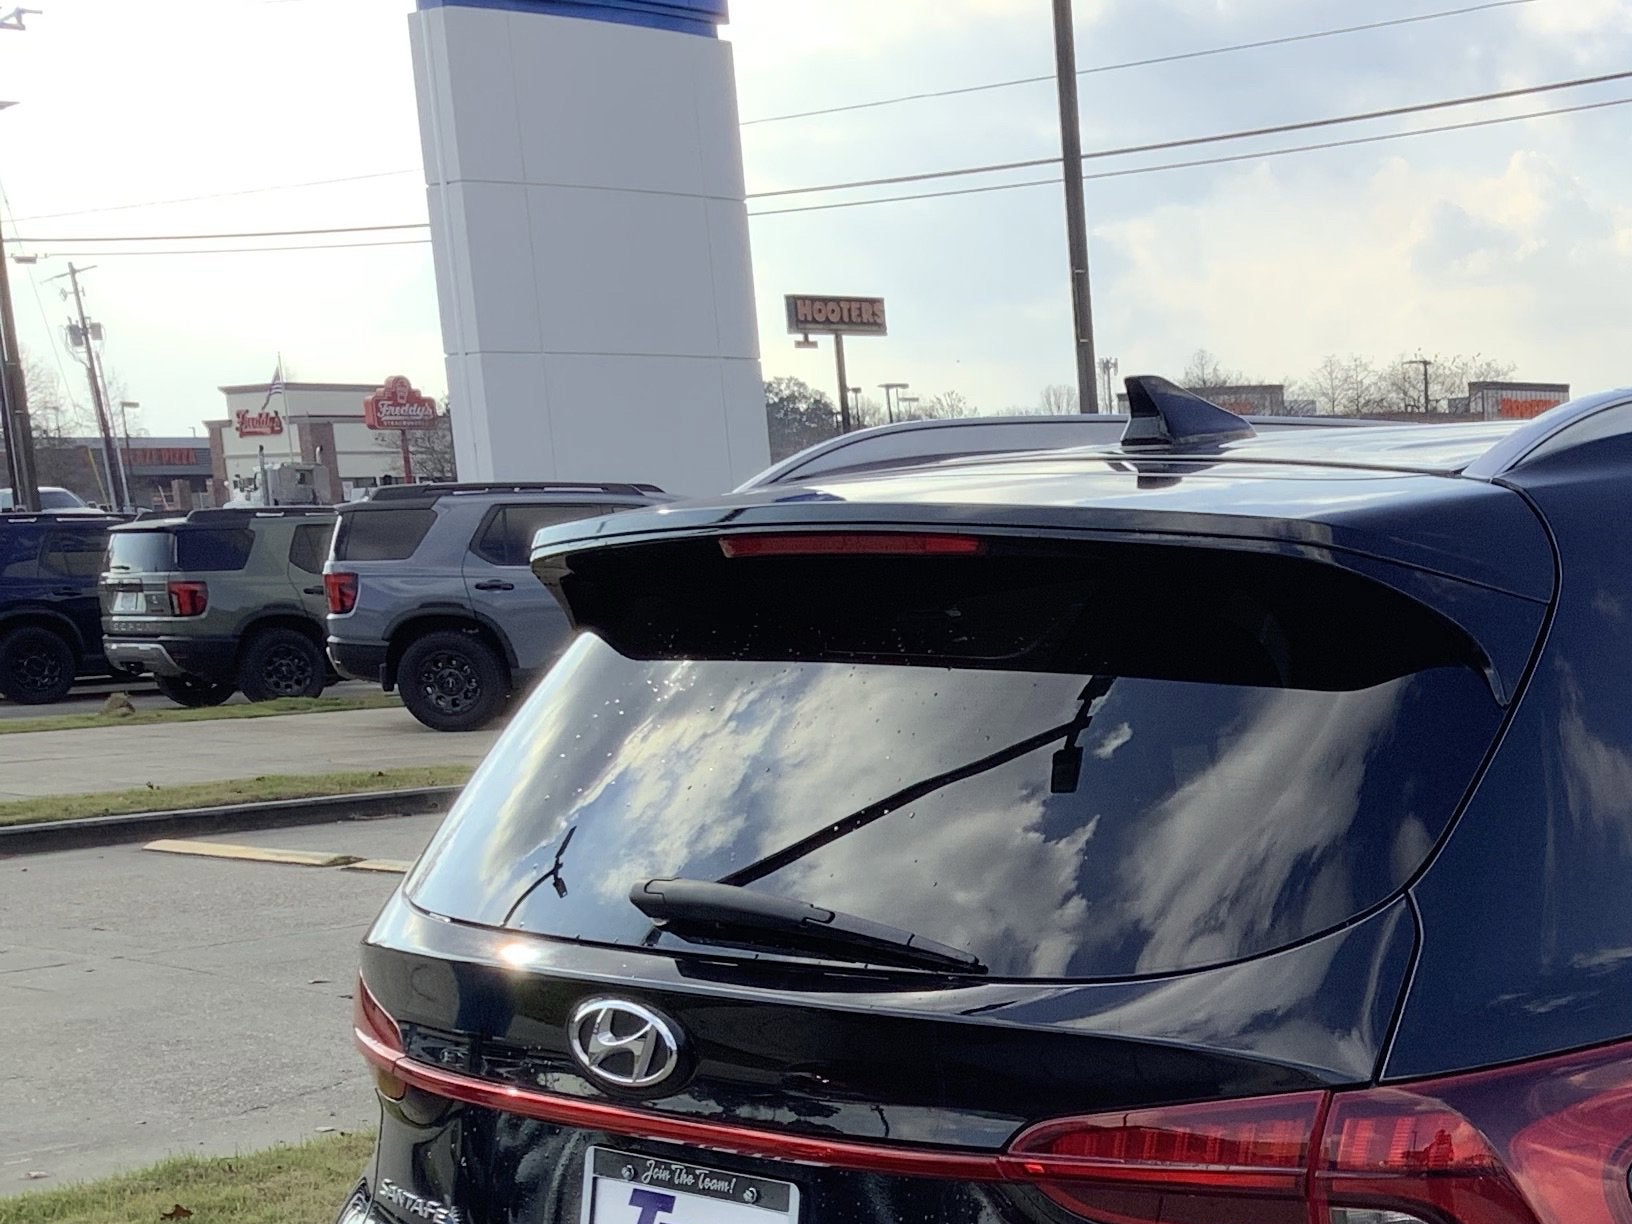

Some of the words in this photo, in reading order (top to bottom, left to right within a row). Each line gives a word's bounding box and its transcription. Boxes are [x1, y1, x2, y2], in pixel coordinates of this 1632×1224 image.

[796, 299, 885, 324] HOOTERS
[378, 400, 434, 420] Freddy's
[641, 1159, 671, 1185] Join
[670, 1163, 695, 1186] The
[694, 1168, 736, 1194] Team!
